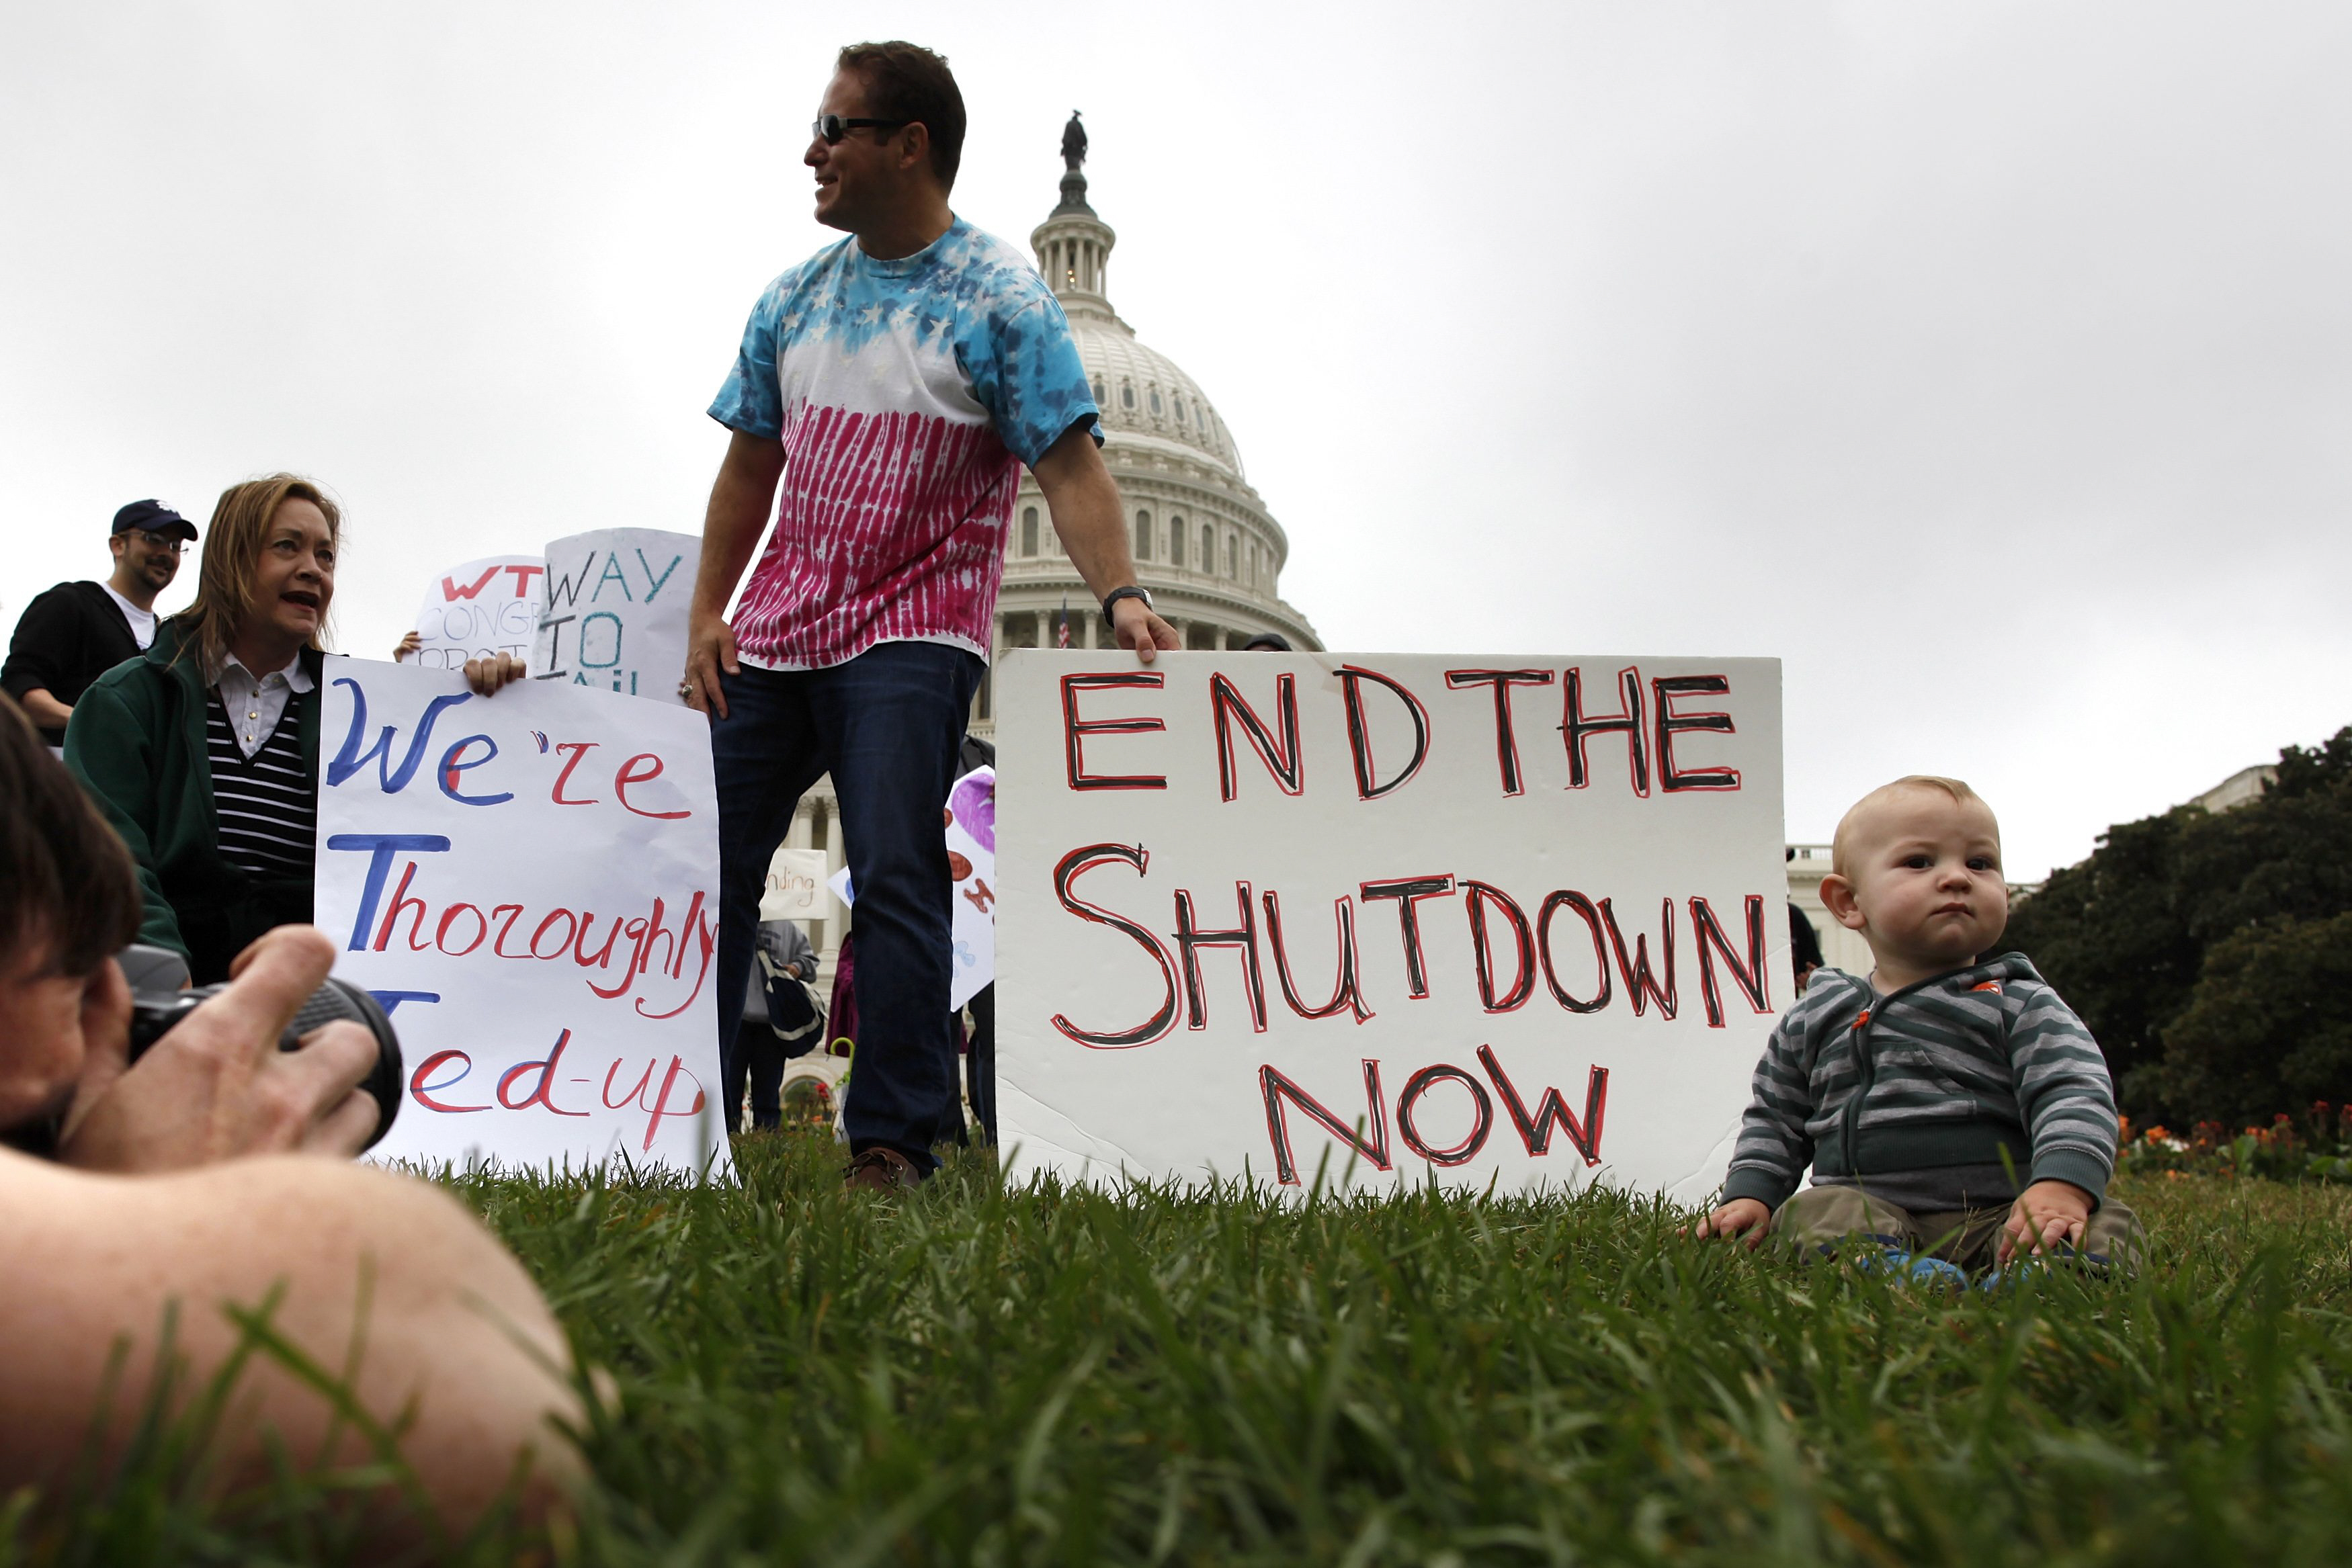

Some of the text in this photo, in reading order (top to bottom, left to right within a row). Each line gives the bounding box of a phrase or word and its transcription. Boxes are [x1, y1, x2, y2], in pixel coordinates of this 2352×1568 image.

[539, 611, 623, 670] TO
[545, 548, 683, 611] WAY
[326, 677, 693, 820] We're
[1060, 664, 1742, 802] END THE
[327, 834, 720, 1019] Thoroughly
[1050, 842, 1775, 1049] SHUTDOWN
[1259, 1044, 1609, 1186] NOW
